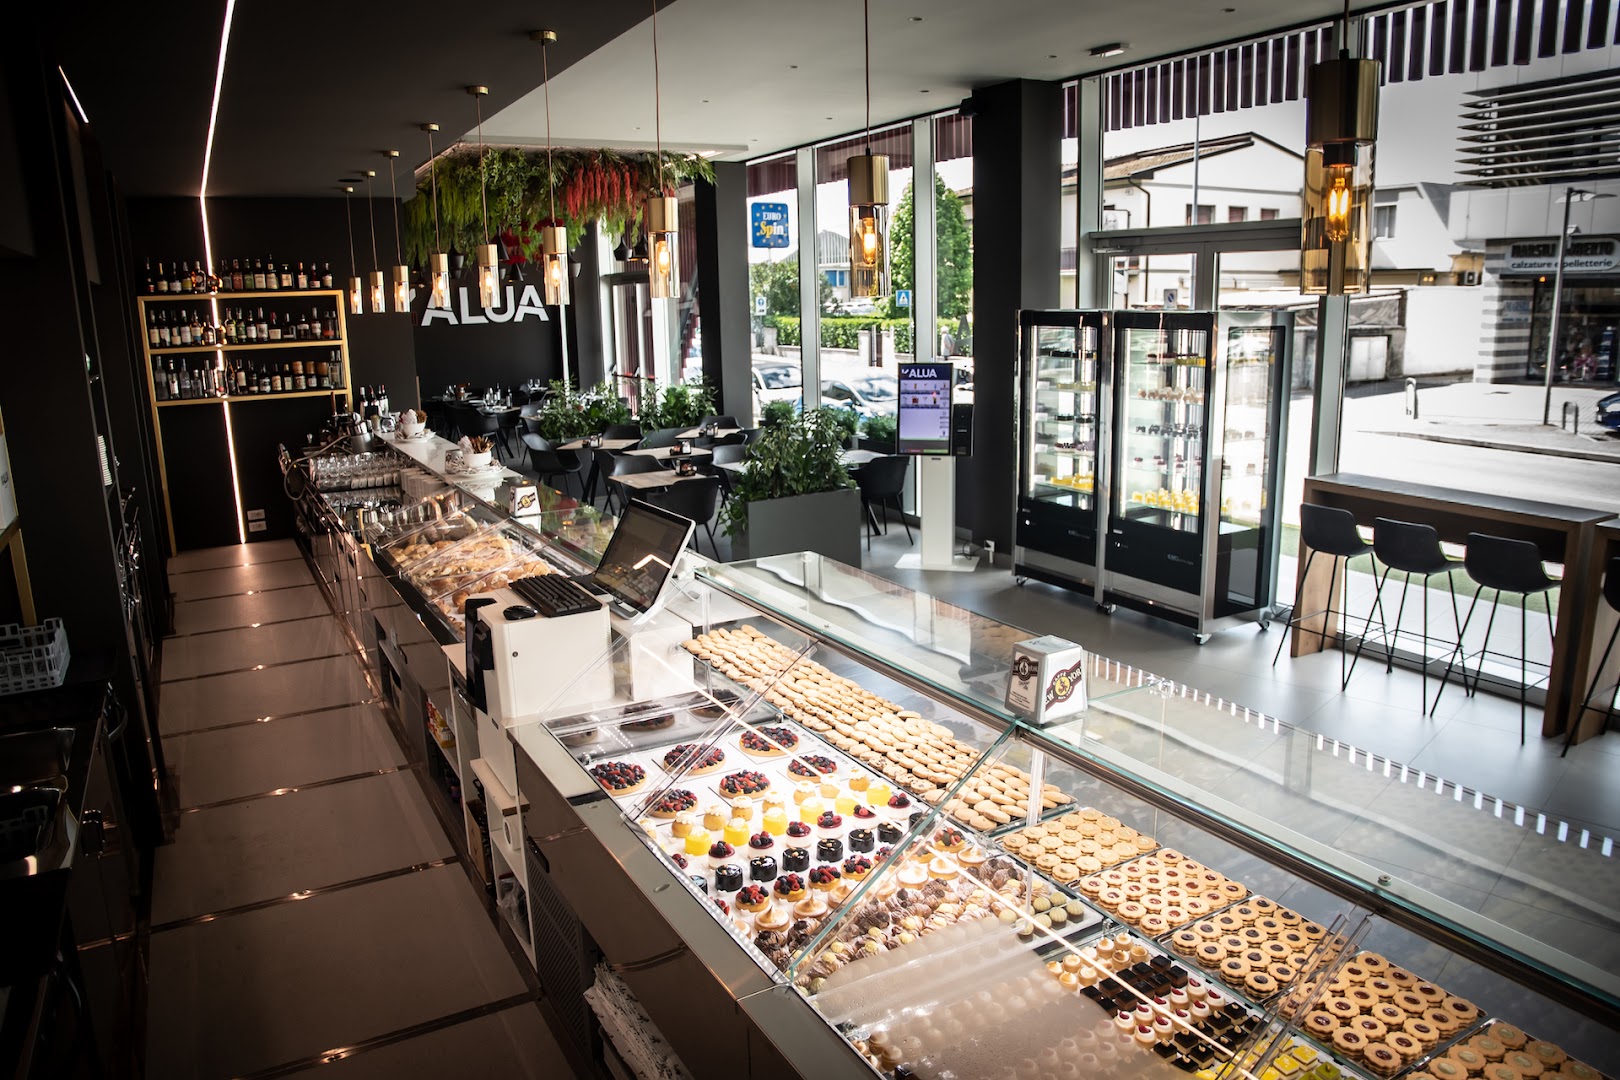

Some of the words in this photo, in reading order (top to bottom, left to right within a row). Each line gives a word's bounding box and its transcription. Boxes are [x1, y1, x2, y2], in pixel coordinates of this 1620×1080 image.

[762, 211, 782, 221] EURO
[760, 220, 785, 239] Spin
[1511, 261, 1552, 269] calzature
[1562, 258, 1613, 269] pelletterie
